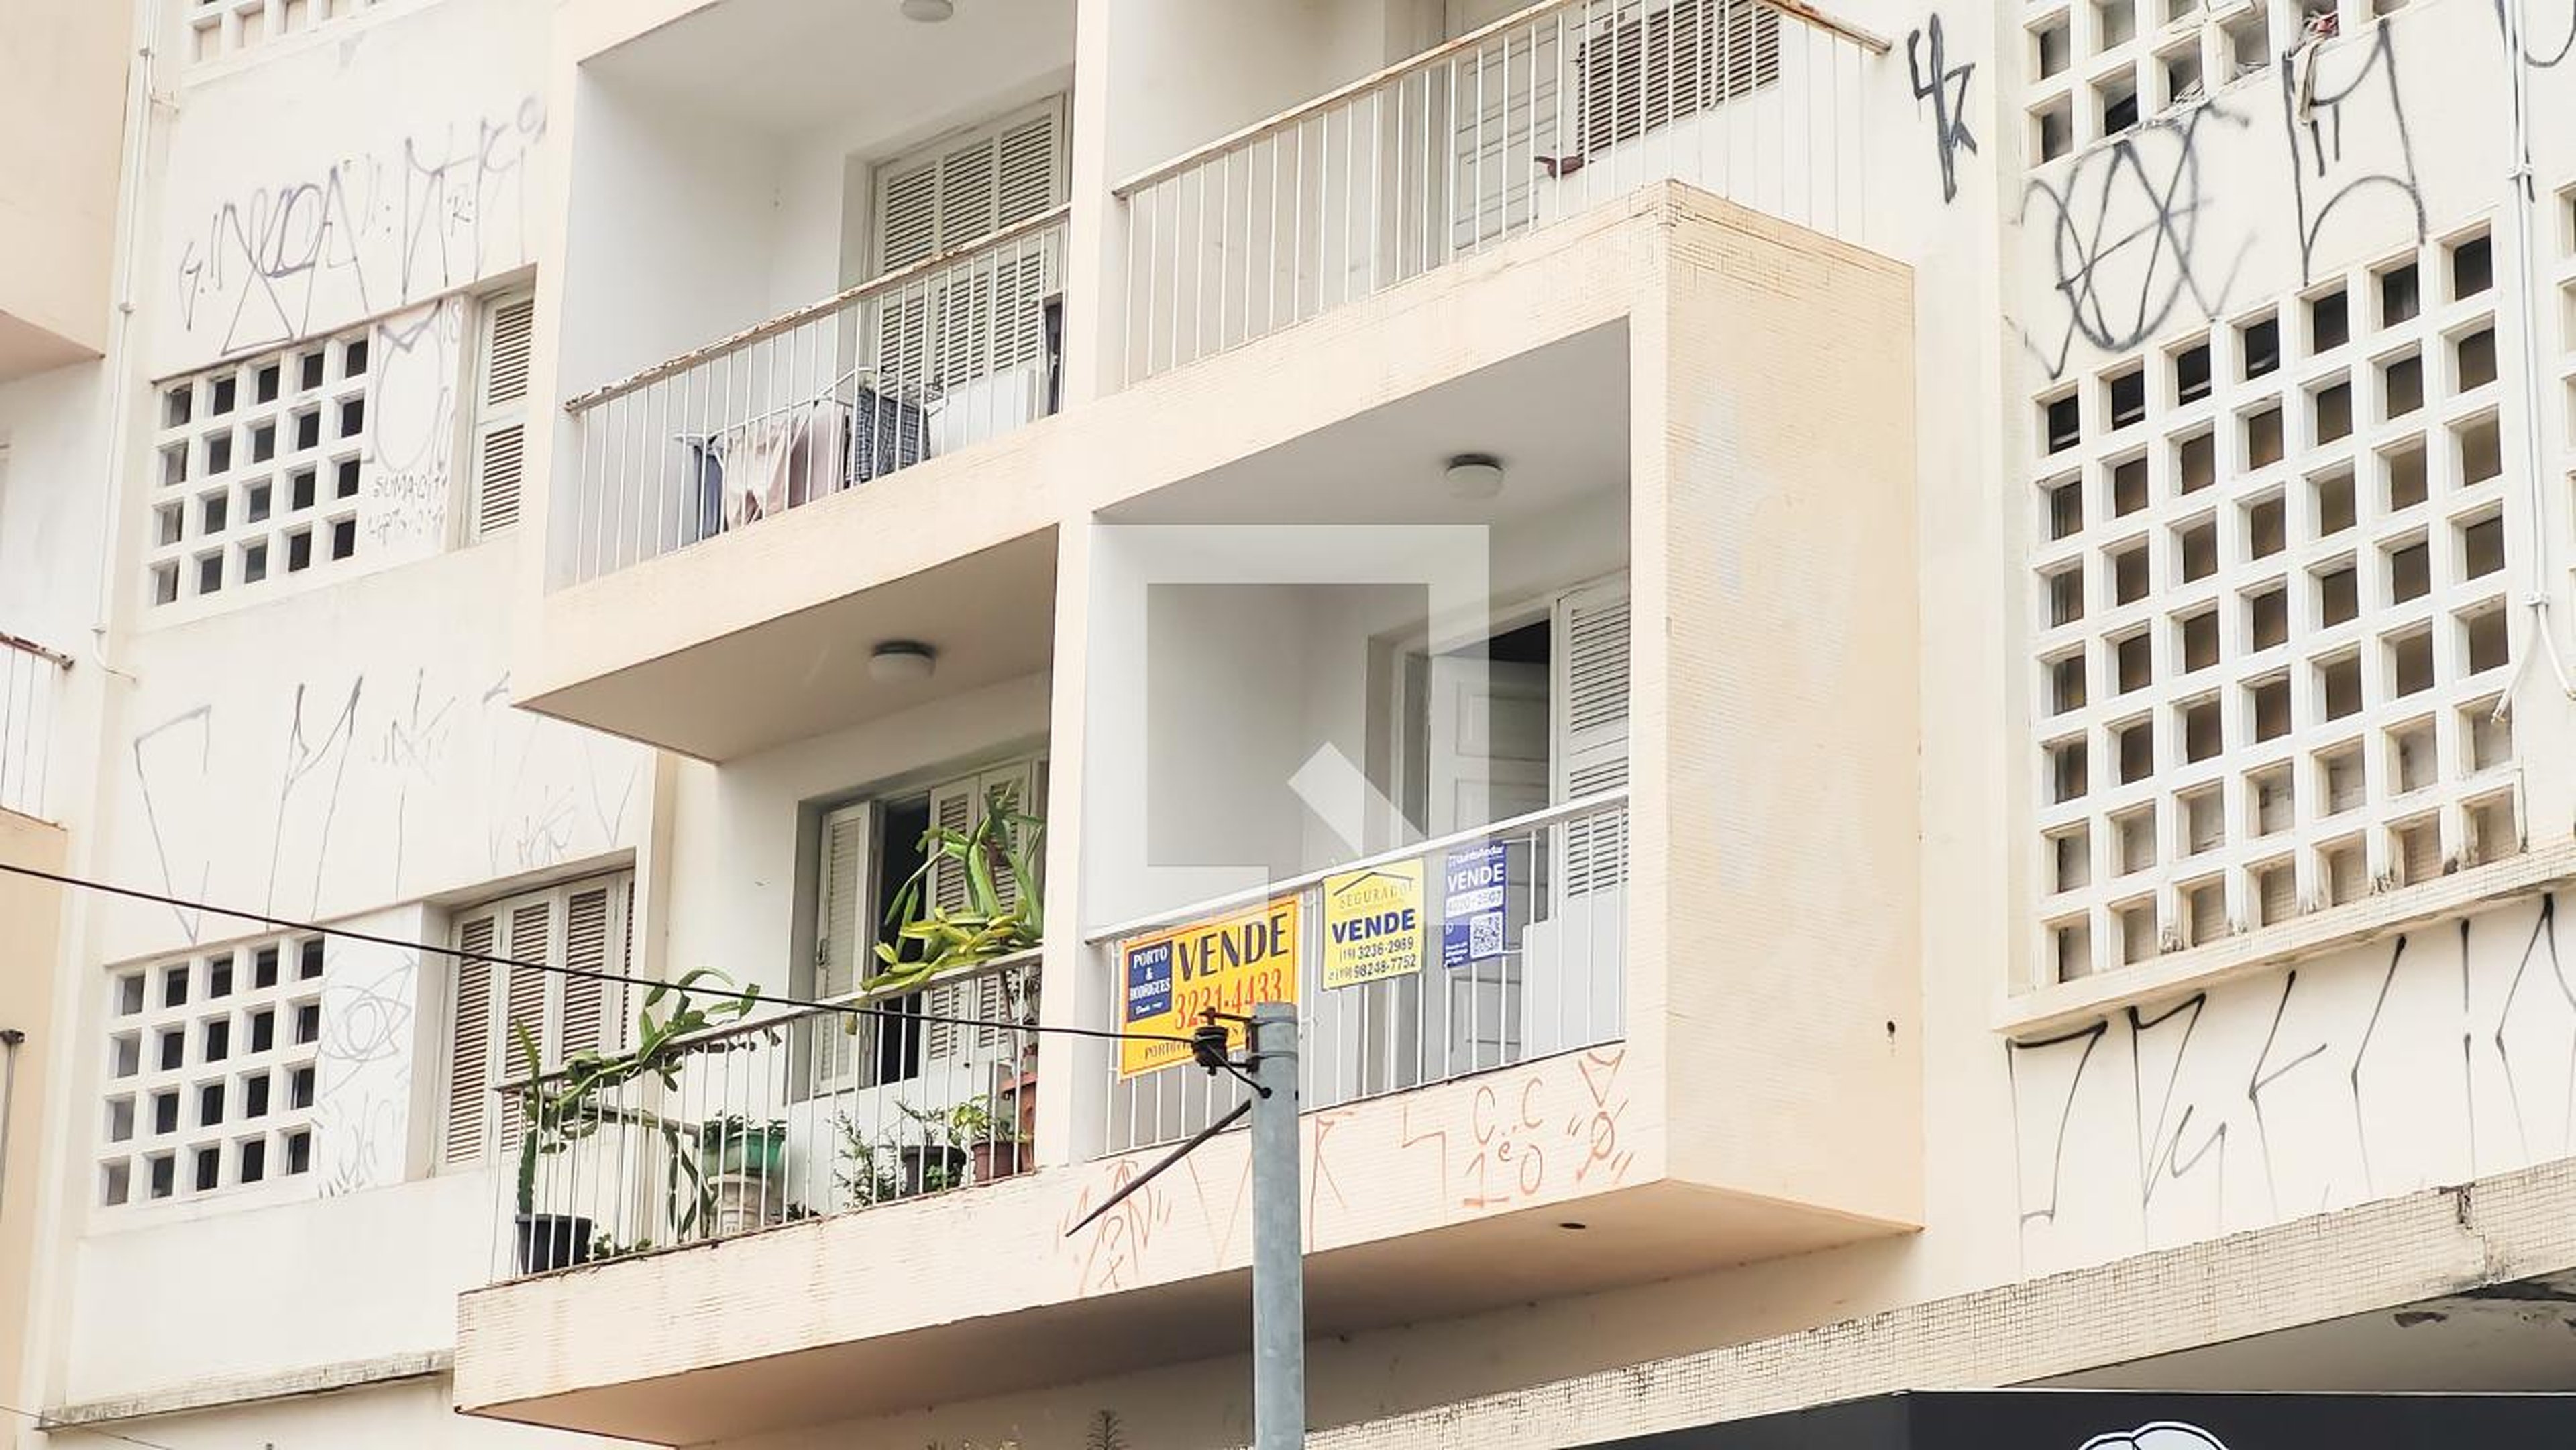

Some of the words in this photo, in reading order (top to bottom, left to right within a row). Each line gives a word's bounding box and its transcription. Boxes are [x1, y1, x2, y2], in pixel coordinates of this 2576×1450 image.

[1447, 862, 1504, 893] VENDE
[1331, 908, 1416, 945] VENDE
[1134, 947, 1168, 969] PORTO
[1178, 913, 1289, 982] VENDE
[1145, 966, 1153, 980] &
